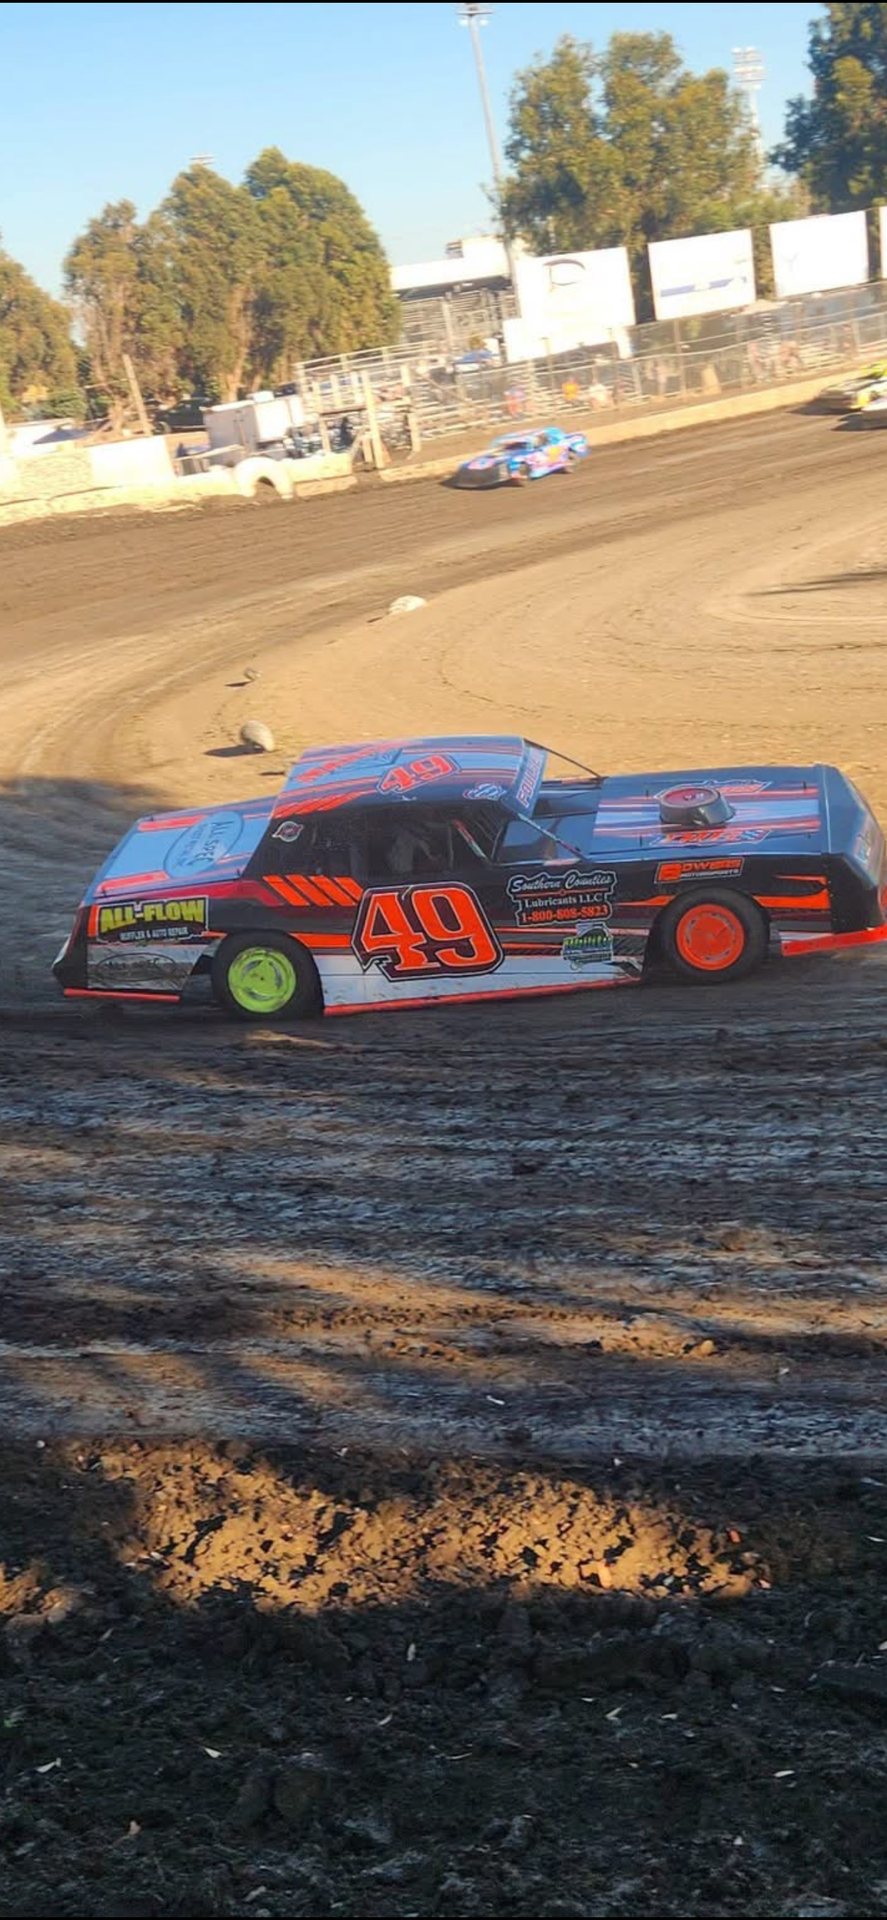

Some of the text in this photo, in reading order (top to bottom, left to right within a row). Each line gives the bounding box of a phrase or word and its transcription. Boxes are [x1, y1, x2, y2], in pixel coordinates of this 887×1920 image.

[378, 754, 456, 793] 49
[511, 873, 612, 893] Southern Counties
[525, 893, 603, 908] Lubricants LLC
[100, 900, 204, 933] ALL-FLOW
[360, 887, 497, 971] 49
[152, 927, 167, 938] AUTO
[168, 926, 189, 937] REPAIR
